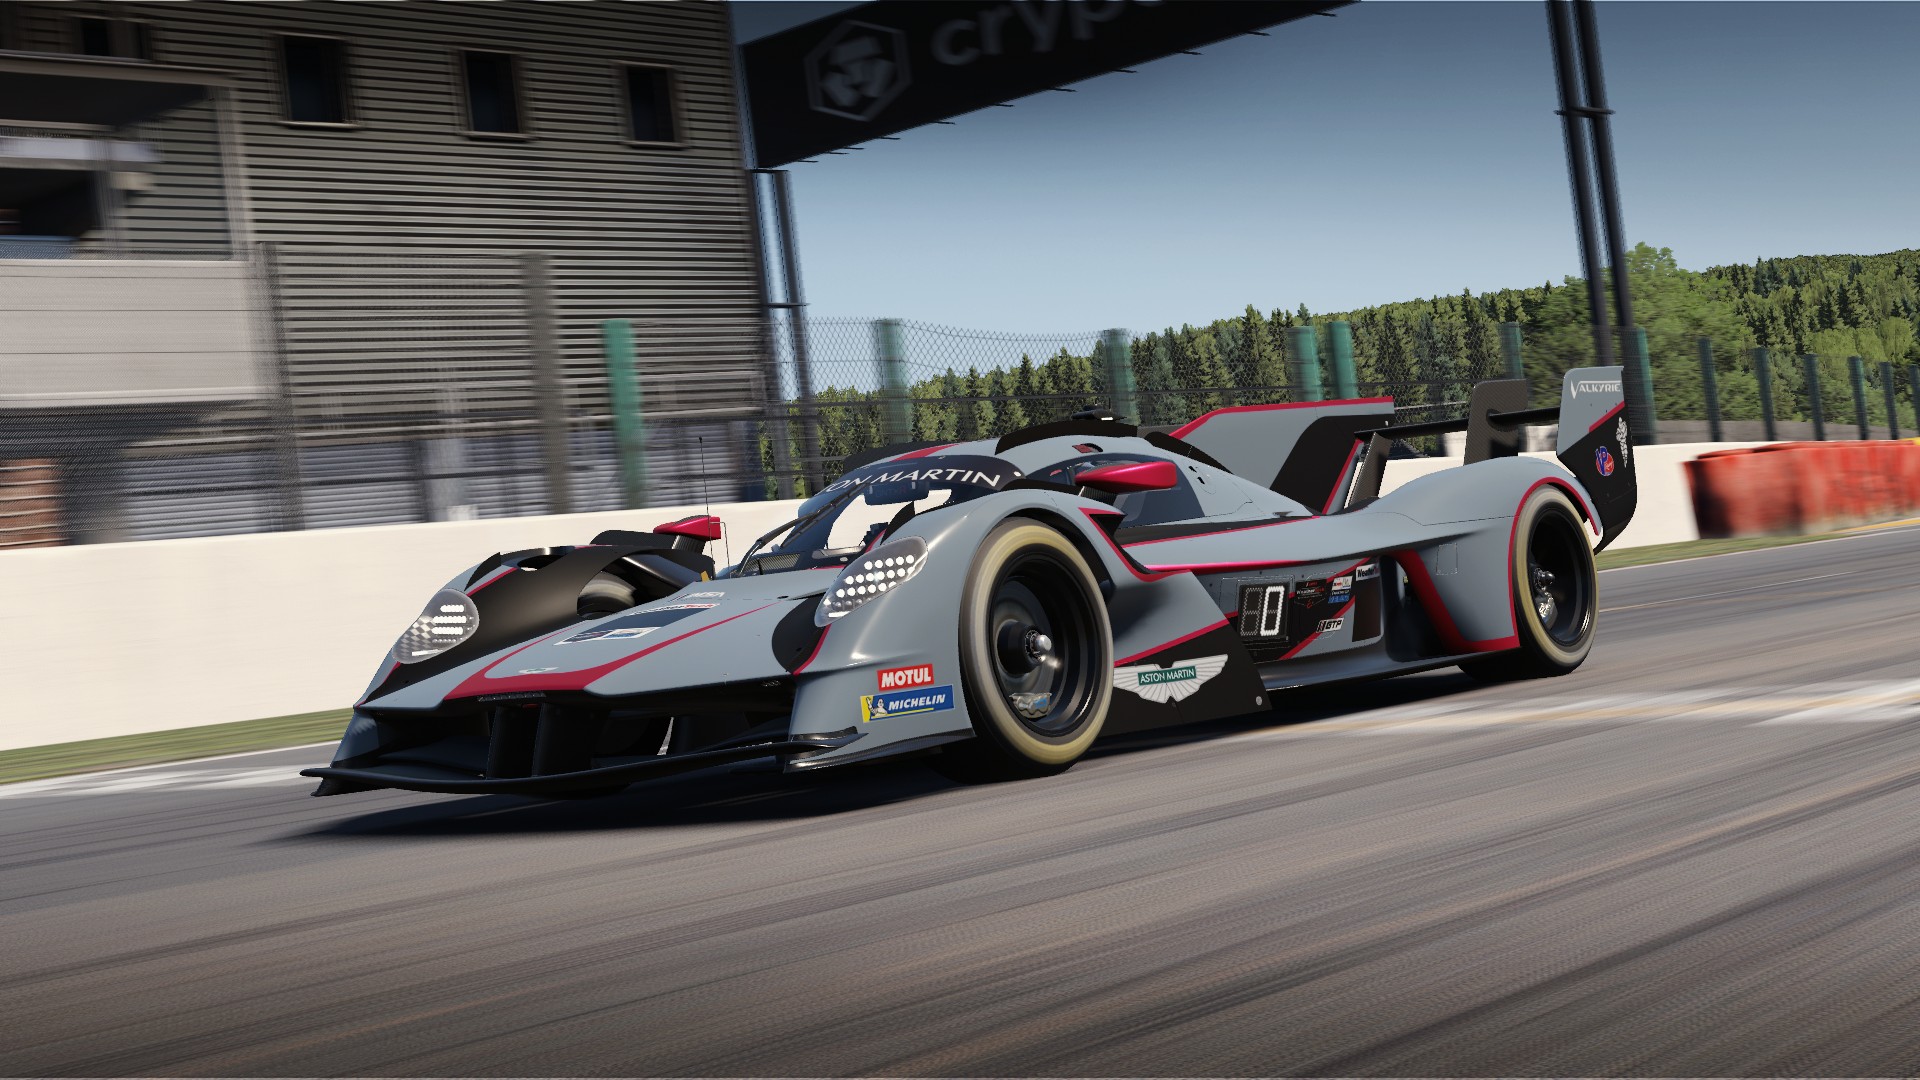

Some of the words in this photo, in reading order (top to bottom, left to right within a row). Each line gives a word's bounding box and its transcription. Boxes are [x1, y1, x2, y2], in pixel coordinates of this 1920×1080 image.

[1570, 380, 1621, 399] VALKYRIE
[870, 468, 1001, 487] MARTIN
[1325, 620, 1343, 631] GTP
[881, 667, 932, 688] MOTUL
[1140, 672, 1165, 684] ASTON
[1166, 668, 1196, 680] MARTIN
[888, 694, 946, 711] MICHELIN
